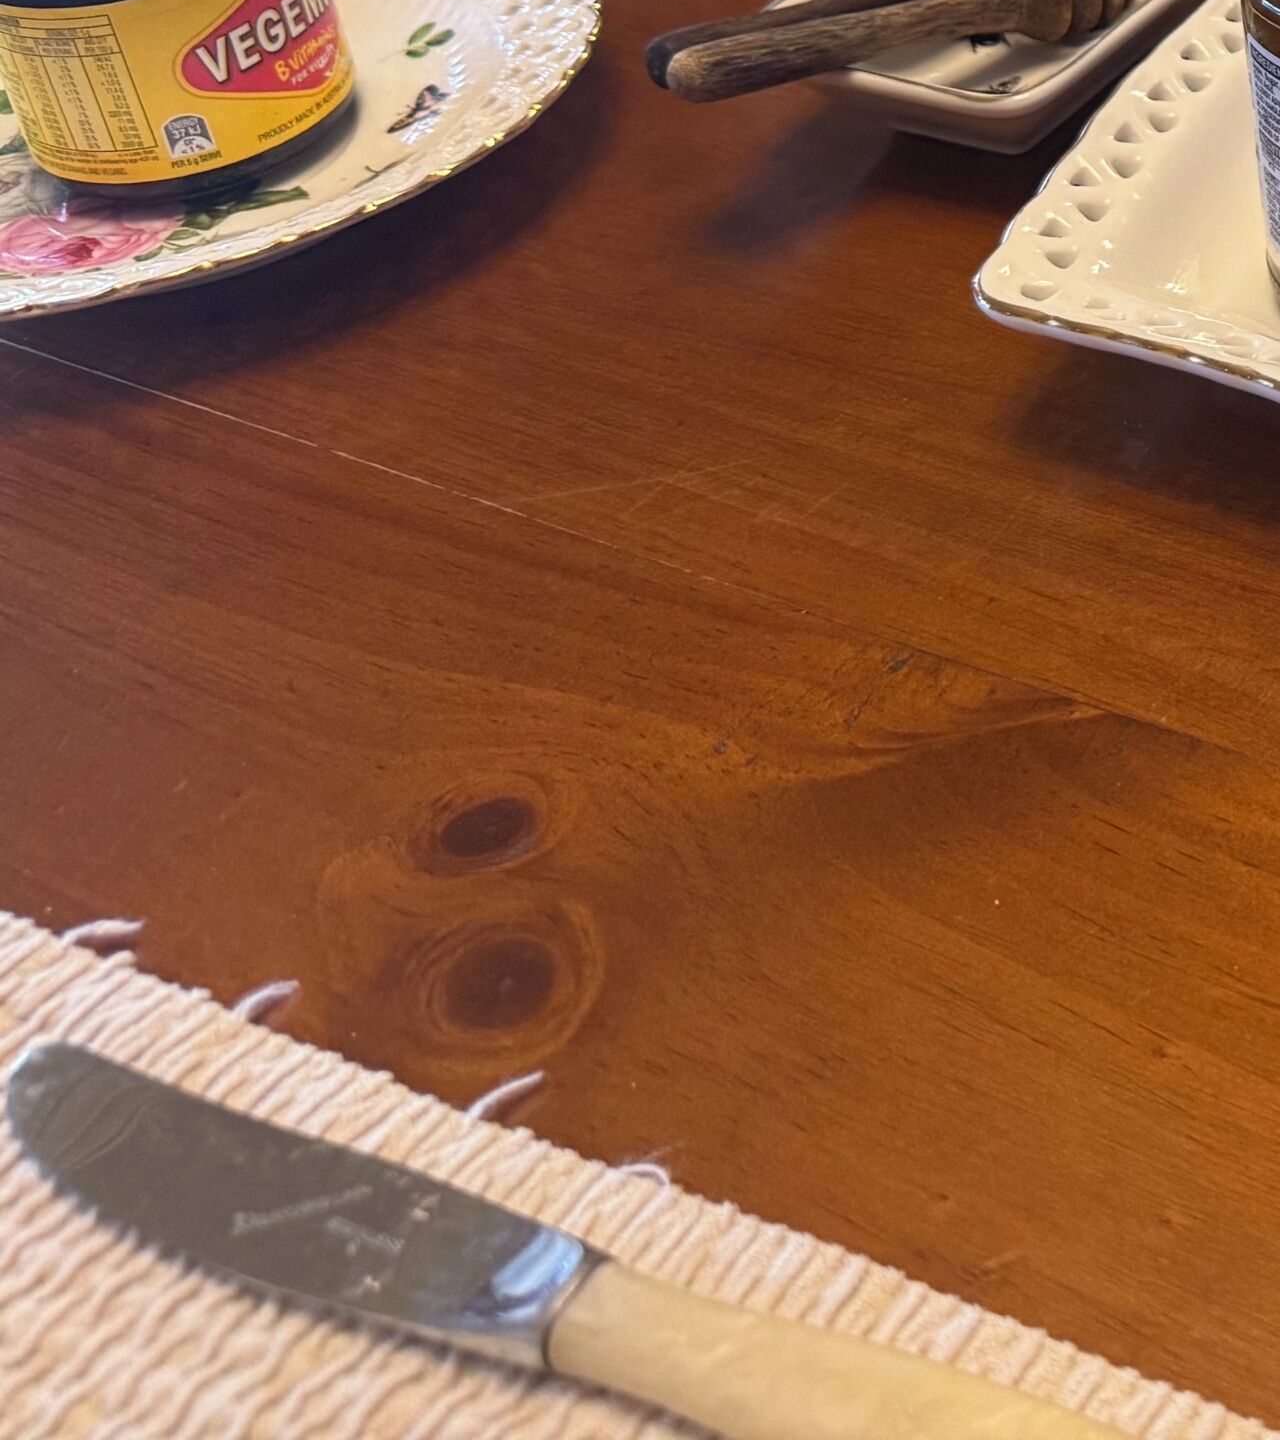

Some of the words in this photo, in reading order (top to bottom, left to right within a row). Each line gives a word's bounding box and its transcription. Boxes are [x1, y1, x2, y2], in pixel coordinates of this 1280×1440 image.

[274, 60, 290, 82] B
[171, 129, 185, 140] 37
[258, 121, 294, 143] PROUDLY
[171, 158, 187, 169] PER
